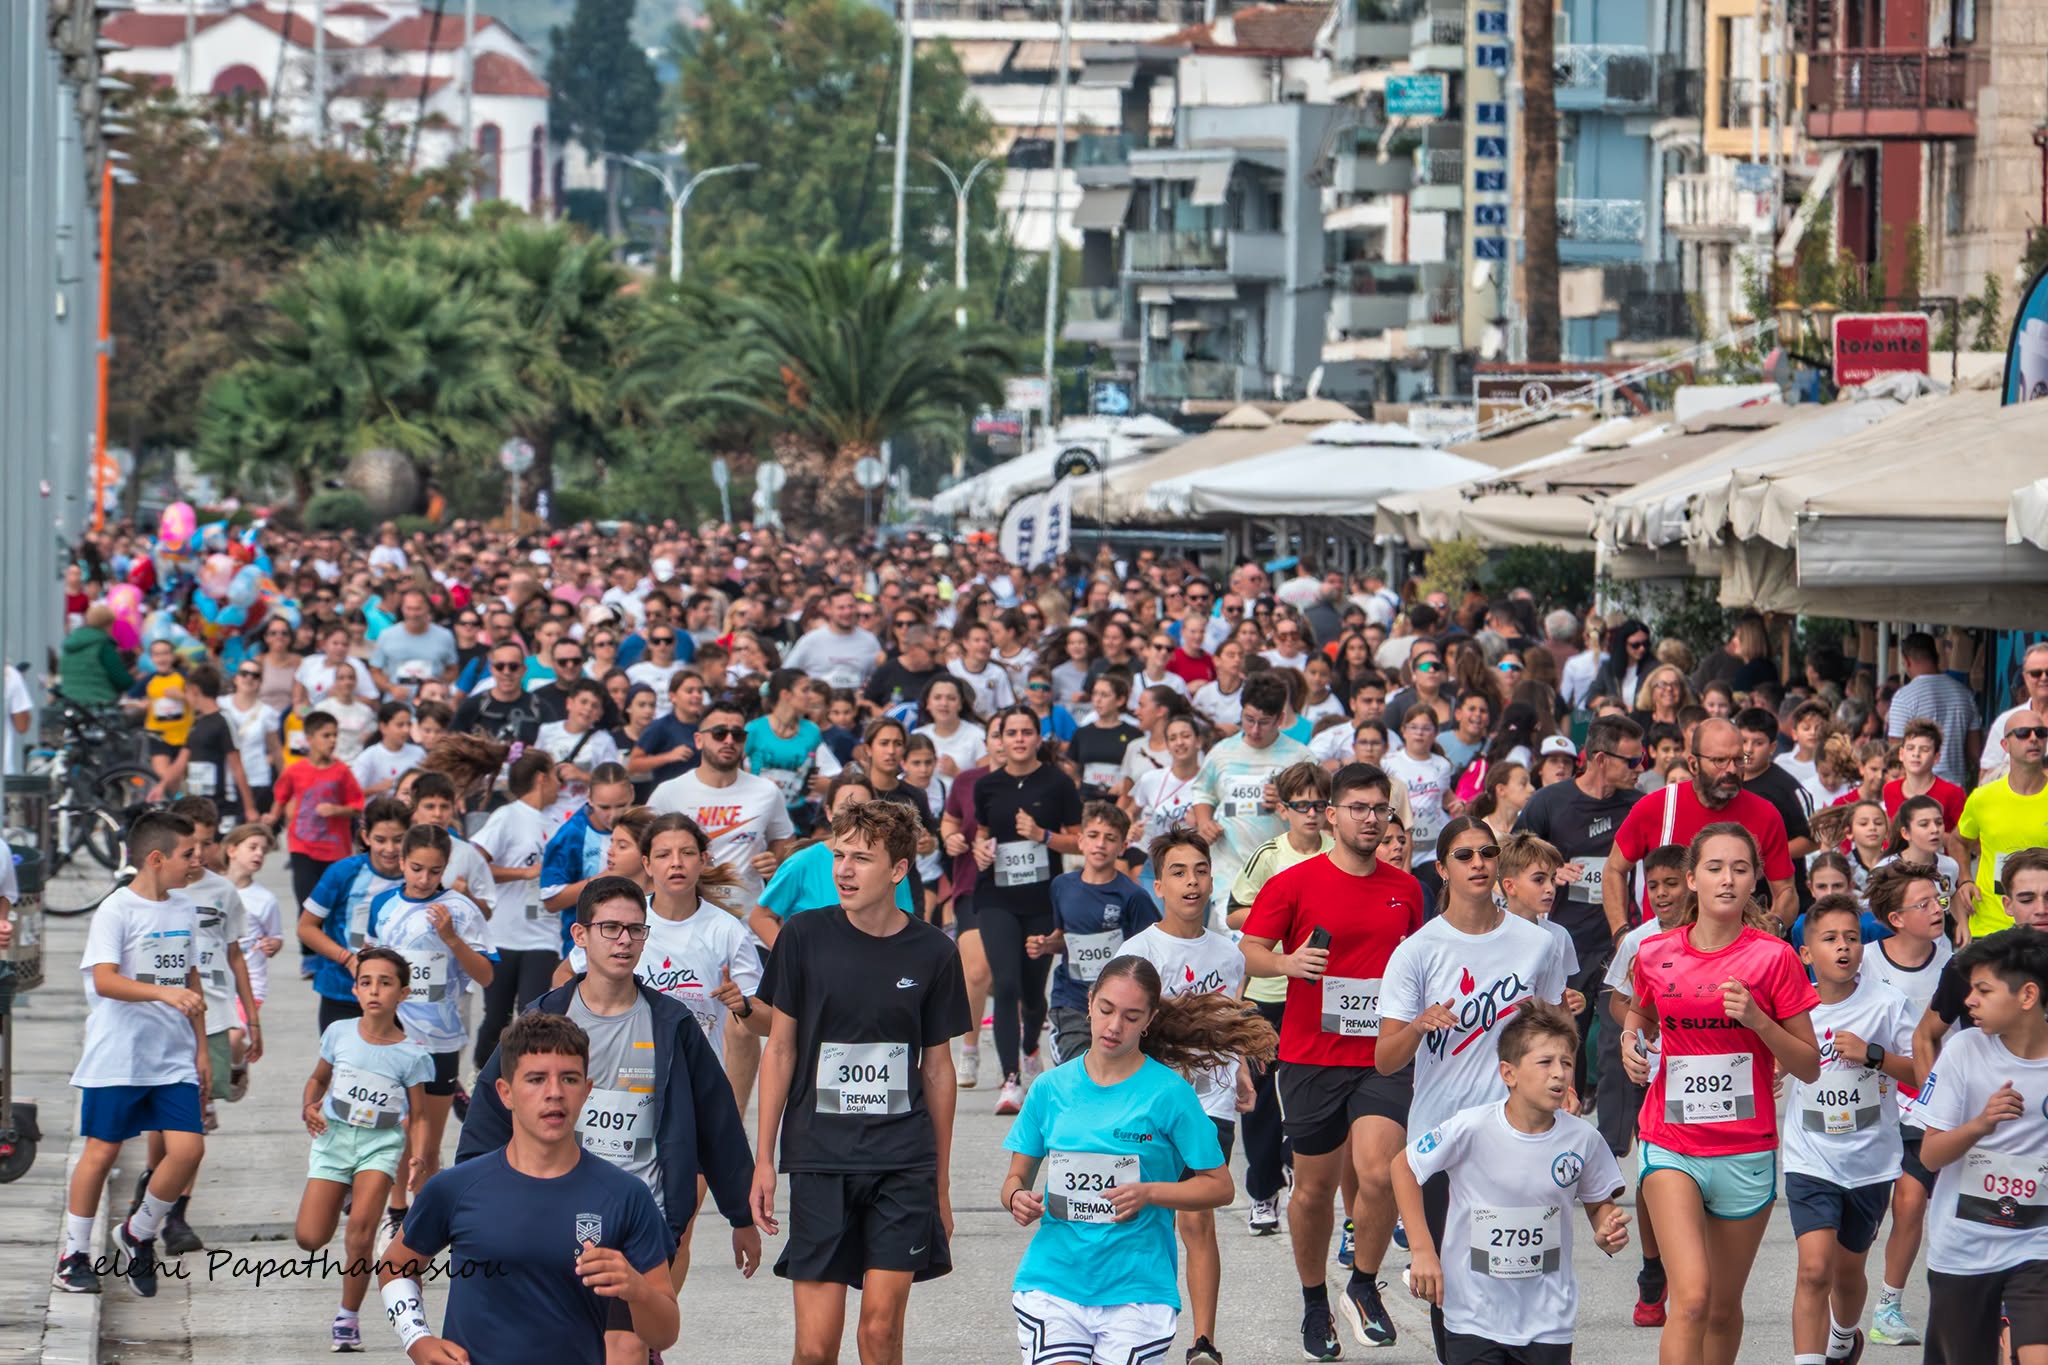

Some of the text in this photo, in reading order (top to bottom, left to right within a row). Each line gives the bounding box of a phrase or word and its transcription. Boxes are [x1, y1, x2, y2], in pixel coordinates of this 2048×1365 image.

[1232, 787, 1261, 799] 4650
[697, 805, 742, 826] NIKE
[1589, 817, 1612, 838] RUN
[1005, 853, 1035, 867] 3019
[1584, 871, 1602, 884] 48
[154, 954, 186, 969] 3635
[1078, 947, 1112, 961] 2906
[411, 966, 431, 980] 36
[1340, 994, 1379, 1011] 3279
[1345, 1019, 1378, 1029] REMAX
[839, 1064, 890, 1083] 3004
[1684, 1075, 1733, 1094] 2892
[347, 1086, 389, 1107] 4042
[846, 1094, 887, 1105] REMAX
[1816, 1089, 1861, 1106] 4084
[846, 1104, 866, 1112] Δομή
[586, 1109, 638, 1131] 2097
[1113, 1128, 1153, 1143] Europa
[1065, 1172, 1117, 1191] 3234
[1983, 1174, 2037, 1198] 0389
[1073, 1202, 1114, 1214] REMAX
[1490, 1227, 1544, 1247] 2795
